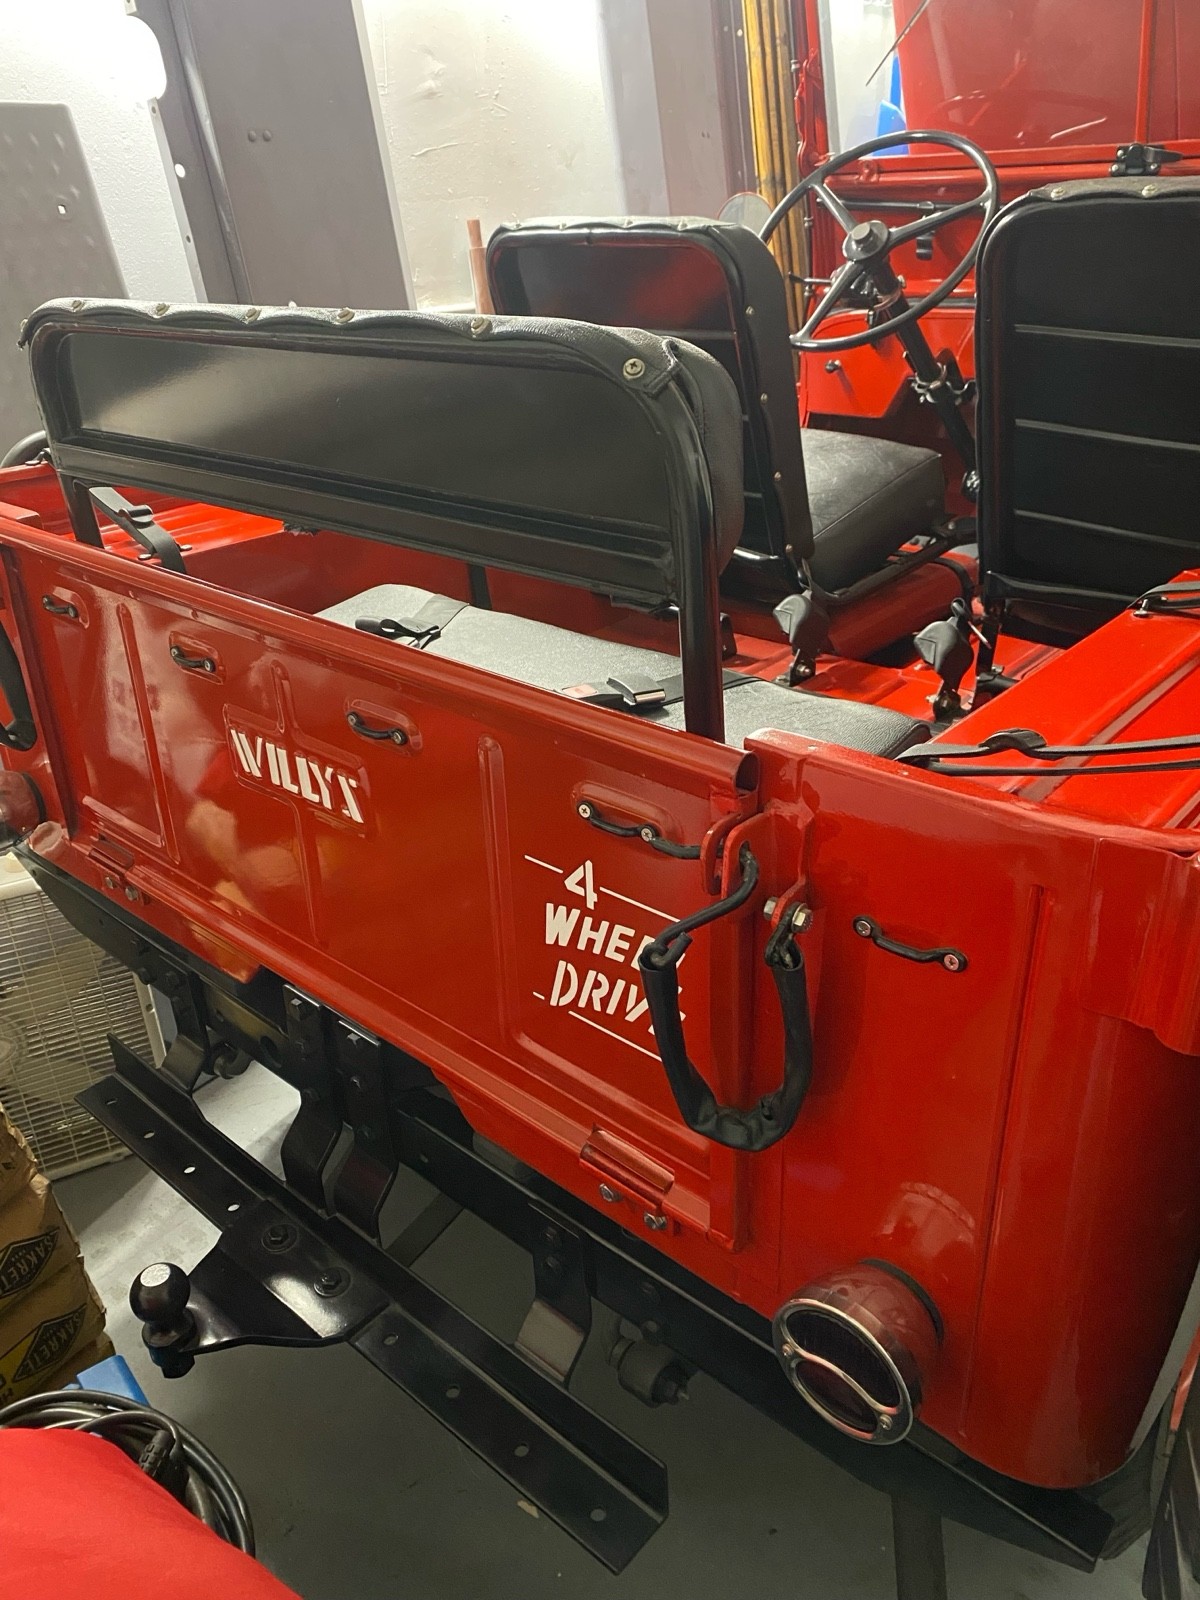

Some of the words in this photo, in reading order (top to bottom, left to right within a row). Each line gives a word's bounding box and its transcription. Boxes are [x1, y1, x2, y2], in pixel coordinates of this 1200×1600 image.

[230, 728, 365, 824] WILLYS
[563, 859, 598, 910] 4
[544, 902, 686, 972] WHE
[549, 959, 687, 1036] DRIV
[0, 1235, 54, 1293] SAKRET
